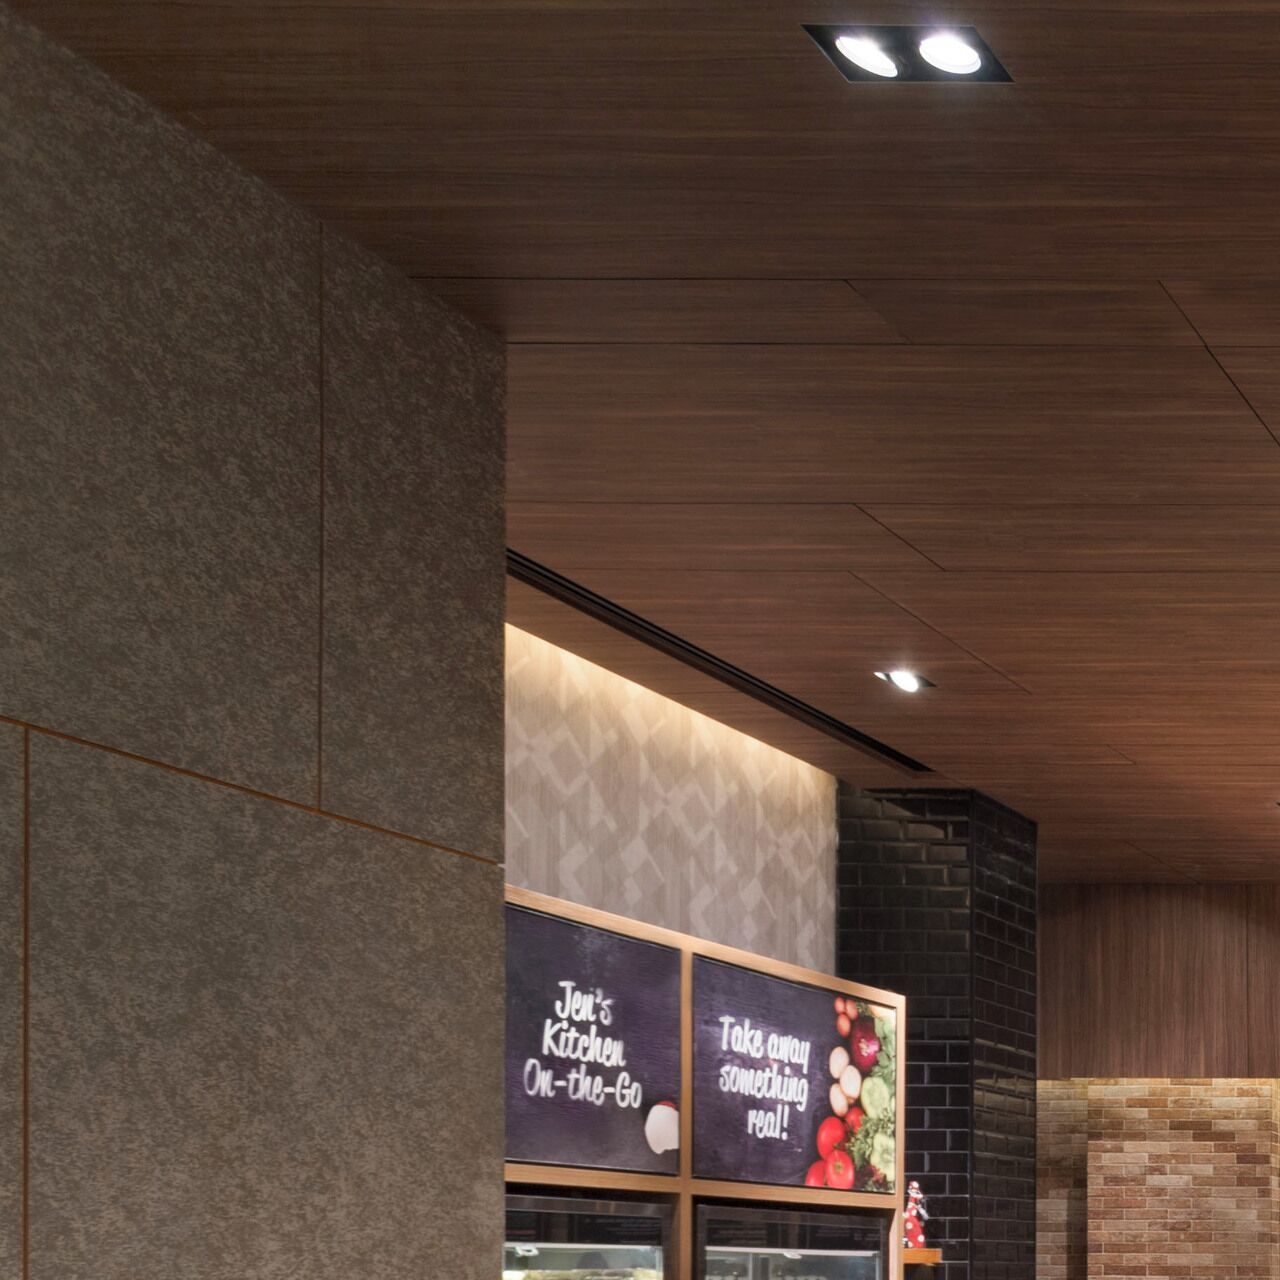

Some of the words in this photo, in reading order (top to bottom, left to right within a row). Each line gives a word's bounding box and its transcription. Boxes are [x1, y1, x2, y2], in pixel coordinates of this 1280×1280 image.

[555, 981, 614, 1025] Jen's
[542, 1018, 627, 1068] Kitchen
[719, 1015, 764, 1060] Take
[767, 1030, 811, 1072] away
[524, 1057, 643, 1109] On-the-Go
[719, 1060, 809, 1112] something
[747, 1103, 789, 1141] real!
